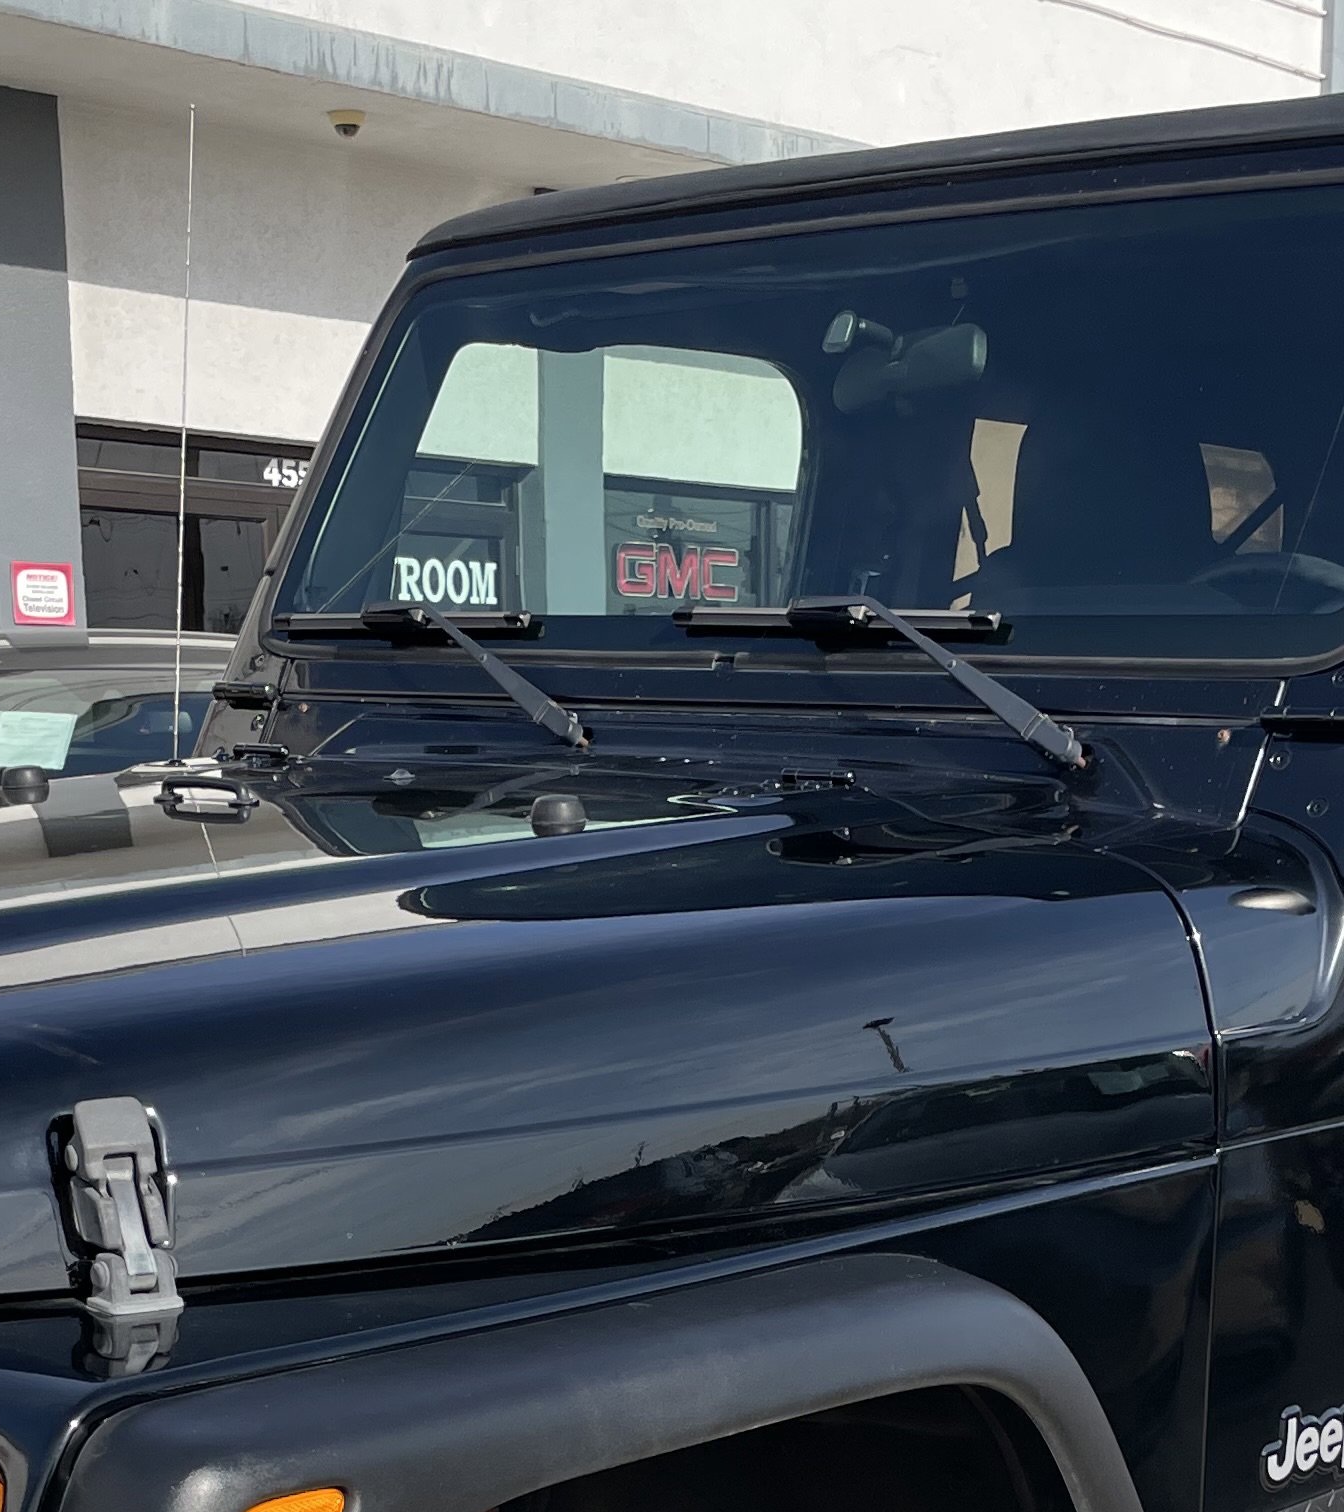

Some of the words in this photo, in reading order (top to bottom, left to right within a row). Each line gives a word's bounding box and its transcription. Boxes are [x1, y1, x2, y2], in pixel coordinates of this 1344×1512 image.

[637, 515, 668, 531] Quality
[669, 517, 717, 532] Pre-Owned
[390, 556, 498, 605] ROOM
[617, 541, 739, 602] GMC
